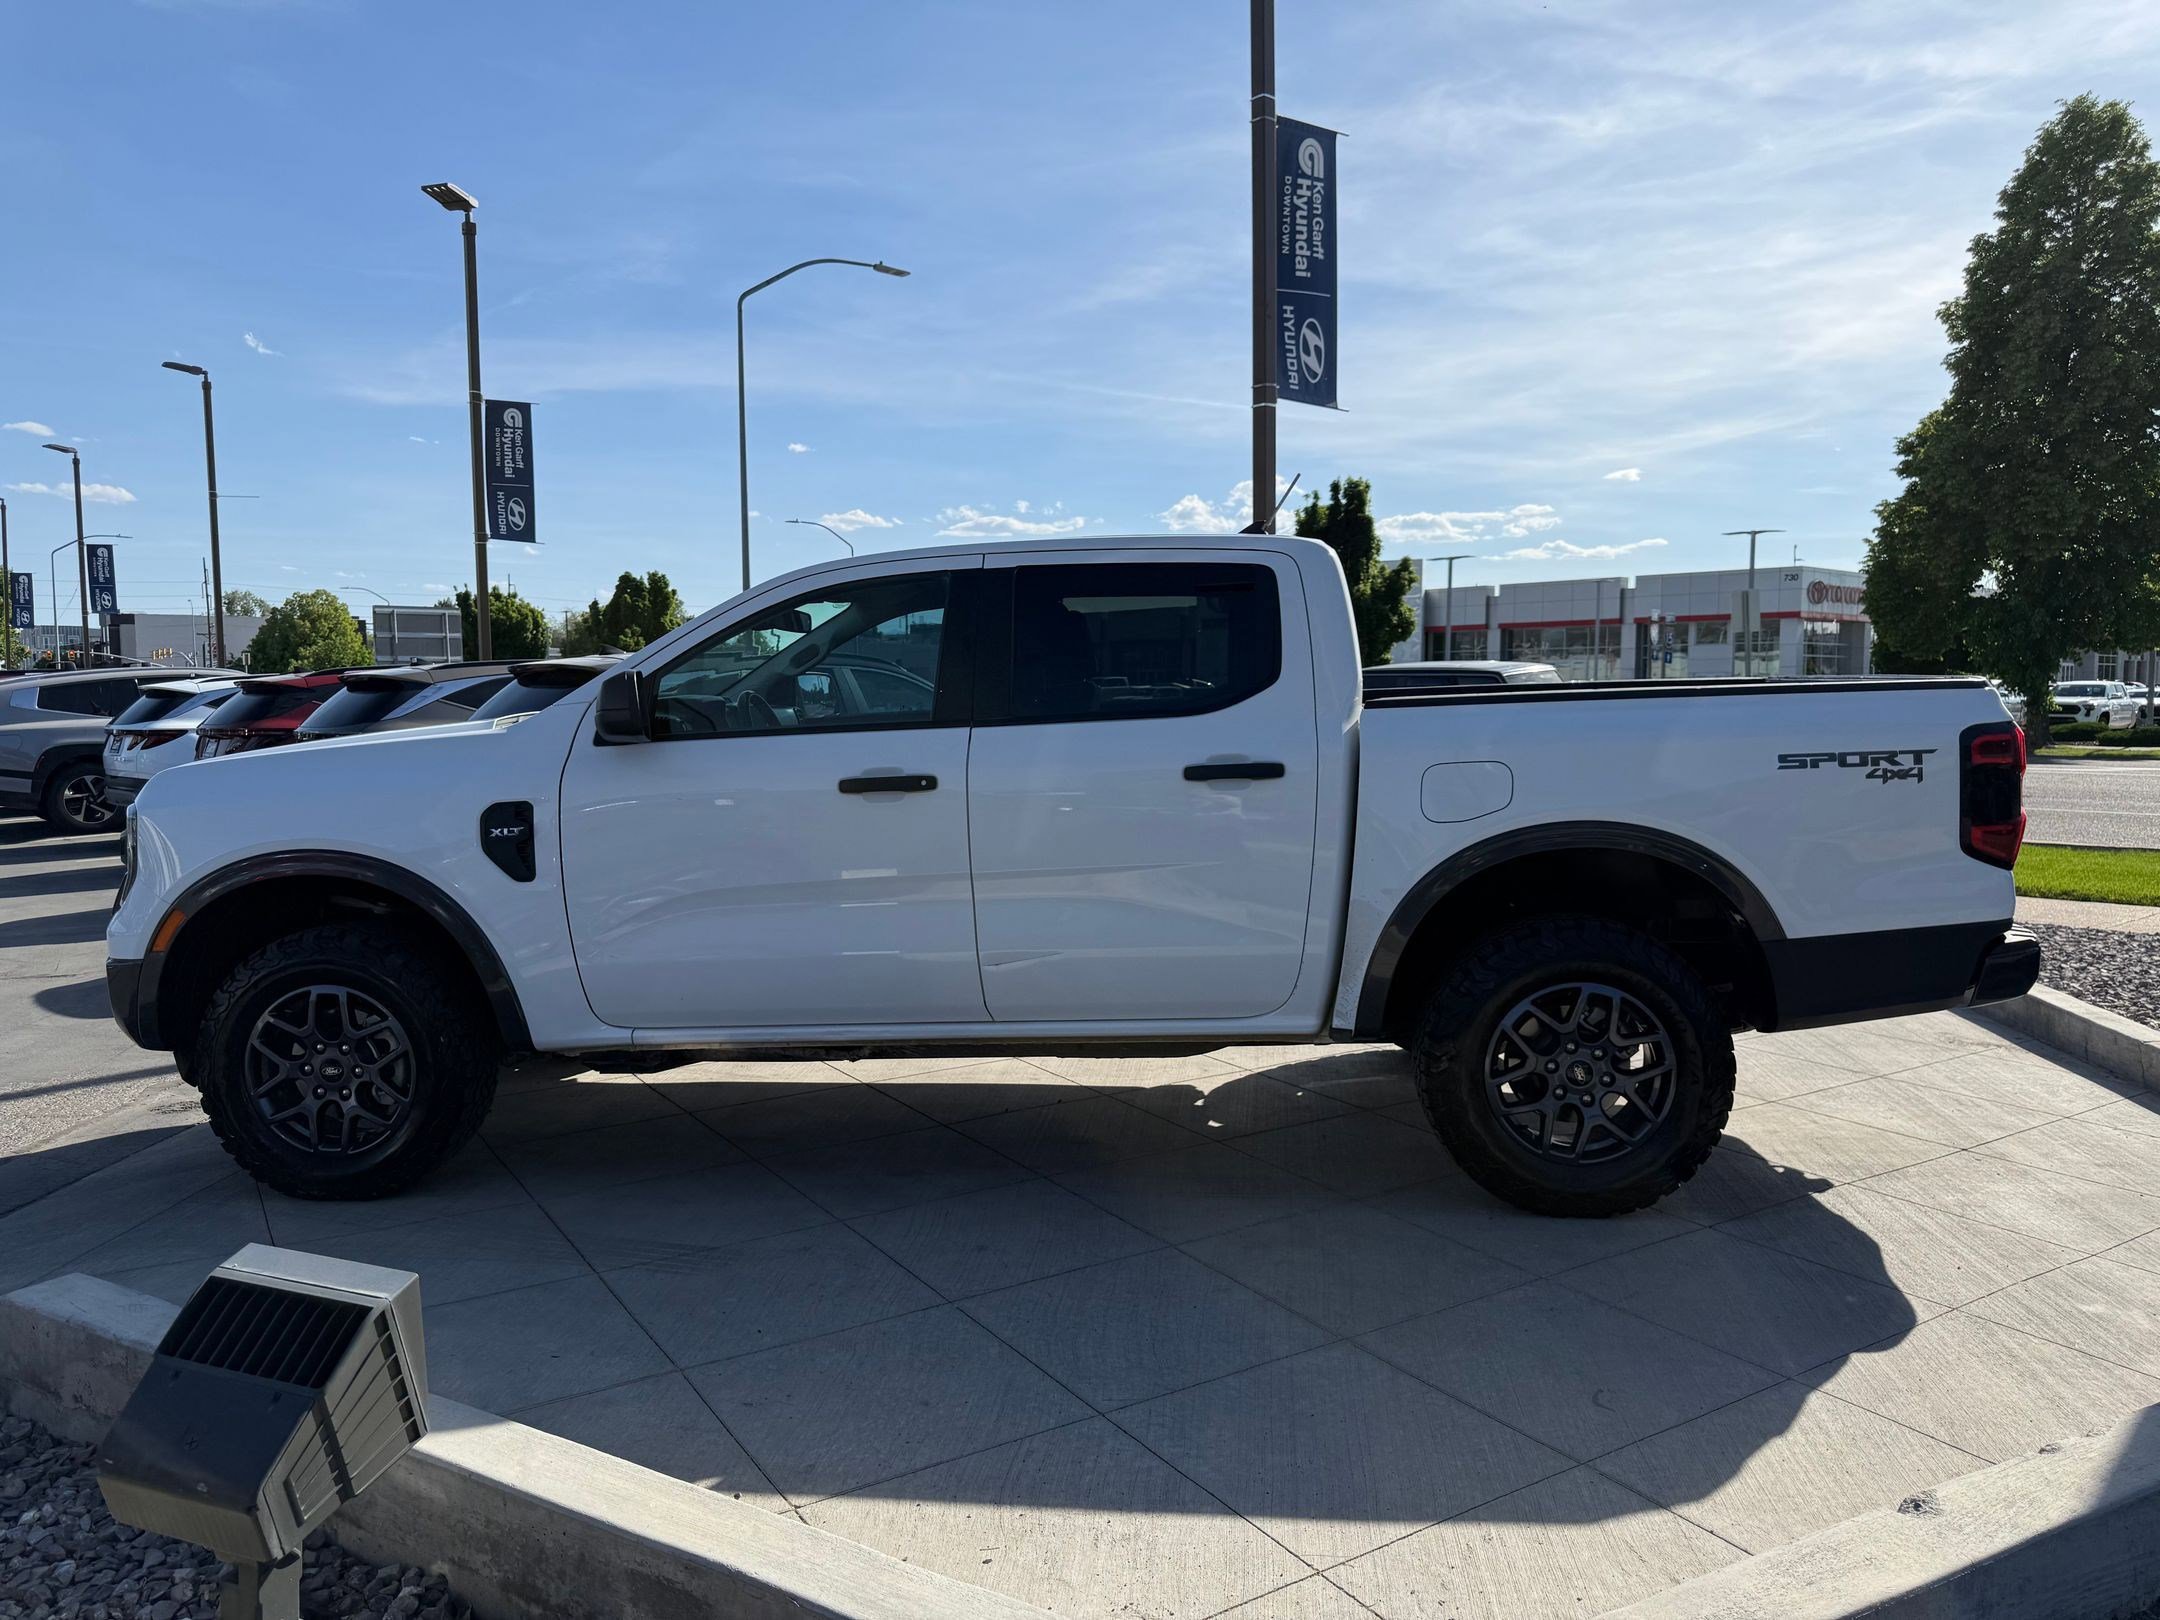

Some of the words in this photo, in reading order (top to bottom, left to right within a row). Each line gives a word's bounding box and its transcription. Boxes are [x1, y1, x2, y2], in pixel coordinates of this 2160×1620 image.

[1281, 175, 1292, 255] DOWNTOWN
[1311, 181, 1324, 216] Ken
[1295, 178, 1312, 278] Hyundai
[1311, 217, 1324, 259] Garff
[1282, 305, 1299, 390] HYUNDAI
[502, 428, 515, 478] Hyundai
[514, 429, 523, 446] Ken
[497, 491, 507, 535] HYUNDAI
[1784, 574, 1799, 582] 730
[1777, 748, 1938, 770] SPORT
[489, 826, 525, 837] XLT
[324, 1067, 339, 1075] Ford
